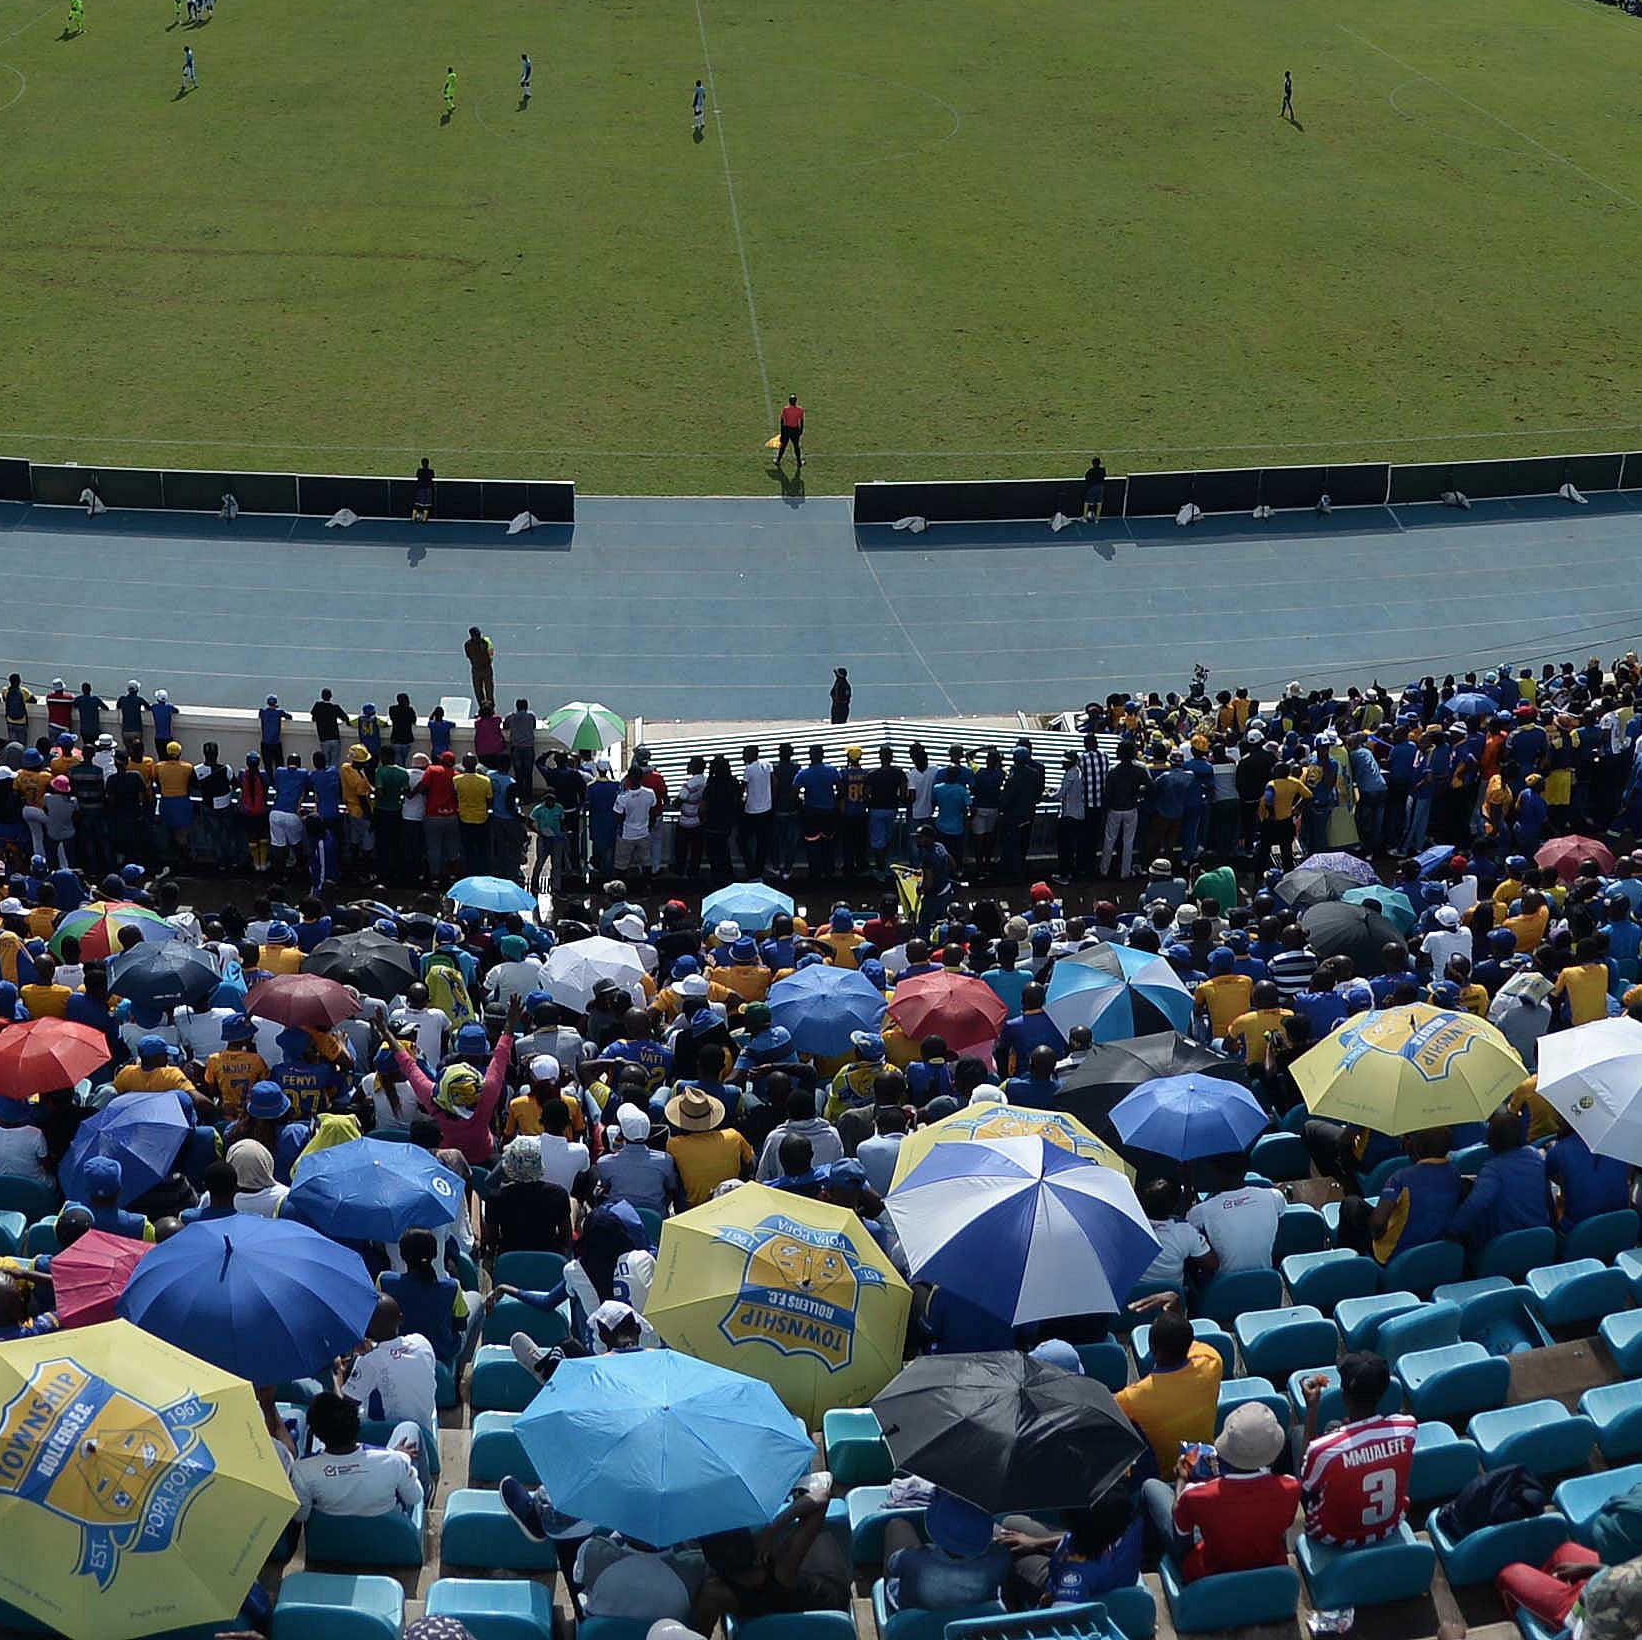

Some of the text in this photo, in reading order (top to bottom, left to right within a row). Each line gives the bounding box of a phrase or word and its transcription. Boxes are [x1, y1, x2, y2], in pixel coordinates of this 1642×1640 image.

[282, 1074, 317, 1087] FENYI
[767, 1290, 835, 1320] ROLLERS F.C.
[741, 1307, 844, 1352] TOWNSHIP
[166, 1399, 202, 1425] 1961
[37, 1419, 80, 1478] ROLLERS
[1342, 1437, 1407, 1469] MMUALEFE
[145, 1495, 171, 1538] POPA
[163, 1458, 205, 1495] POPA
[1362, 1468, 1397, 1526] 3
[90, 1538, 108, 1569] EST.
